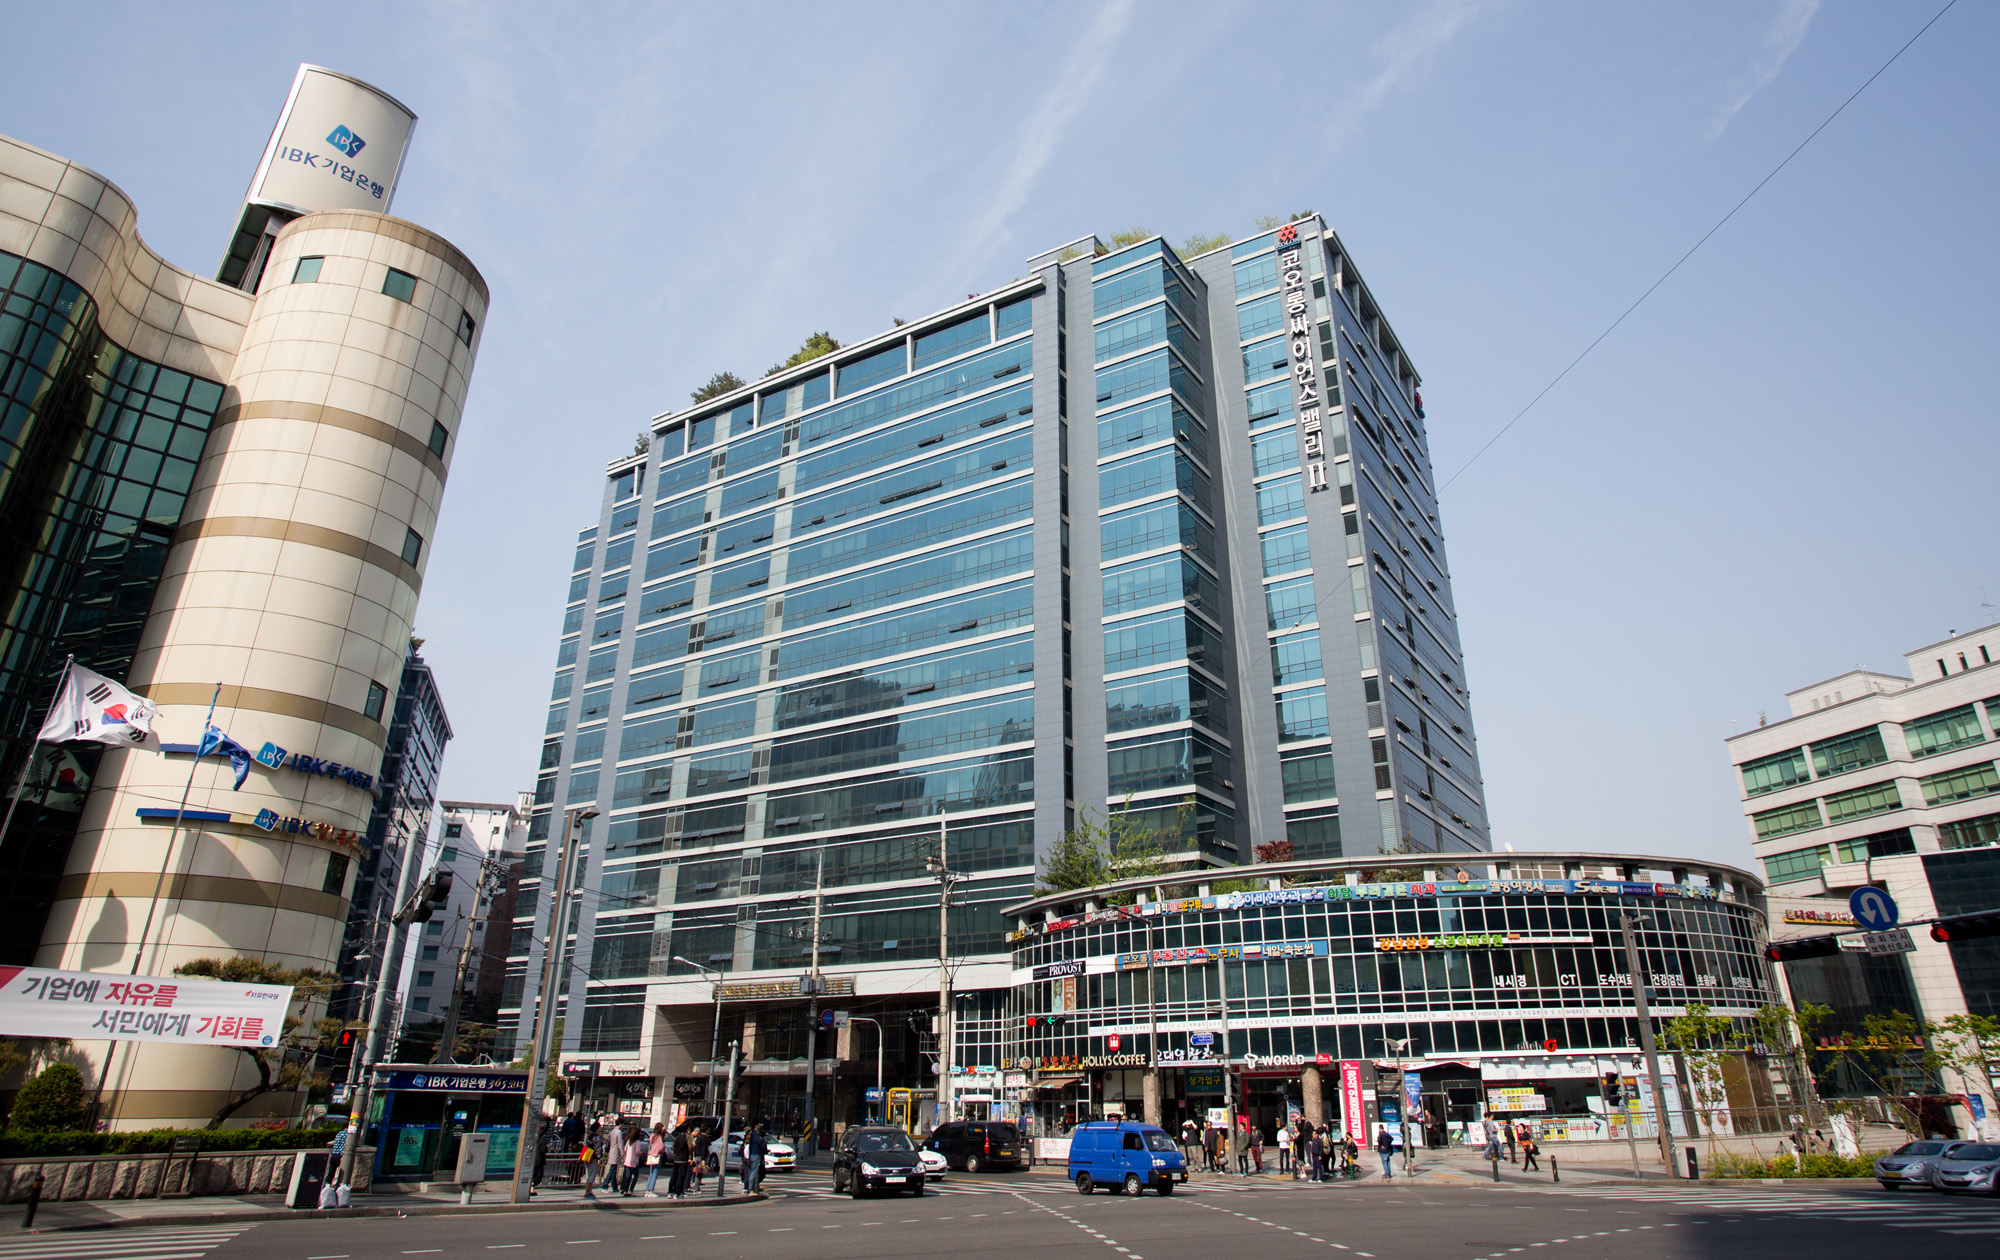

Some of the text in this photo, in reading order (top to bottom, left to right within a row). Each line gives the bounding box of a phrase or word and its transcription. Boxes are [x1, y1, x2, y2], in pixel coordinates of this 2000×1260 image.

[281, 146, 384, 199] IBK 기업은행
[1281, 249, 1324, 459] 코오롱싸이언스밸리
[291, 753, 328, 777] IBK
[327, 761, 374, 789] 투자증권
[281, 816, 315, 837] IBK
[1328, 887, 1352, 899] 이담
[1410, 883, 1437, 896] 치과
[1489, 881, 1545, 894] 웰빙여행사
[1244, 889, 1301, 906] 이비인후과
[1168, 901, 1182, 913] 제본
[1181, 899, 1202, 912] 문구류
[1378, 935, 1430, 951] 강남삼성
[1433, 933, 1504, 949] 신경외과의원
[1866, 932, 1909, 944] 좌회전시
[1871, 943, 1913, 953] 보행신호시
[1123, 953, 1148, 964] 코오롱
[1152, 948, 1188, 962] 부동산
[1049, 962, 1083, 977] PROVOST
[1495, 974, 1528, 988] 내시경
[1560, 974, 1576, 986] CT
[1599, 974, 1633, 987] 도수치료
[1652, 973, 1685, 986] 건강검진
[1697, 975, 1717, 987] 초음파
[21, 976, 178, 1008] 기업에 자유를
[250, 991, 280, 1000] 자유한국당
[92, 1010, 264, 1041] 서민에게 기회를
[1083, 1055, 1113, 1068] HOLLYS
[1113, 1053, 1146, 1067] COFFEE
[1261, 1054, 1305, 1067] WORLD
[428, 1076, 525, 1090] IBK 기업은행 365 코너
[1188, 1075, 1221, 1087] 상가입구
